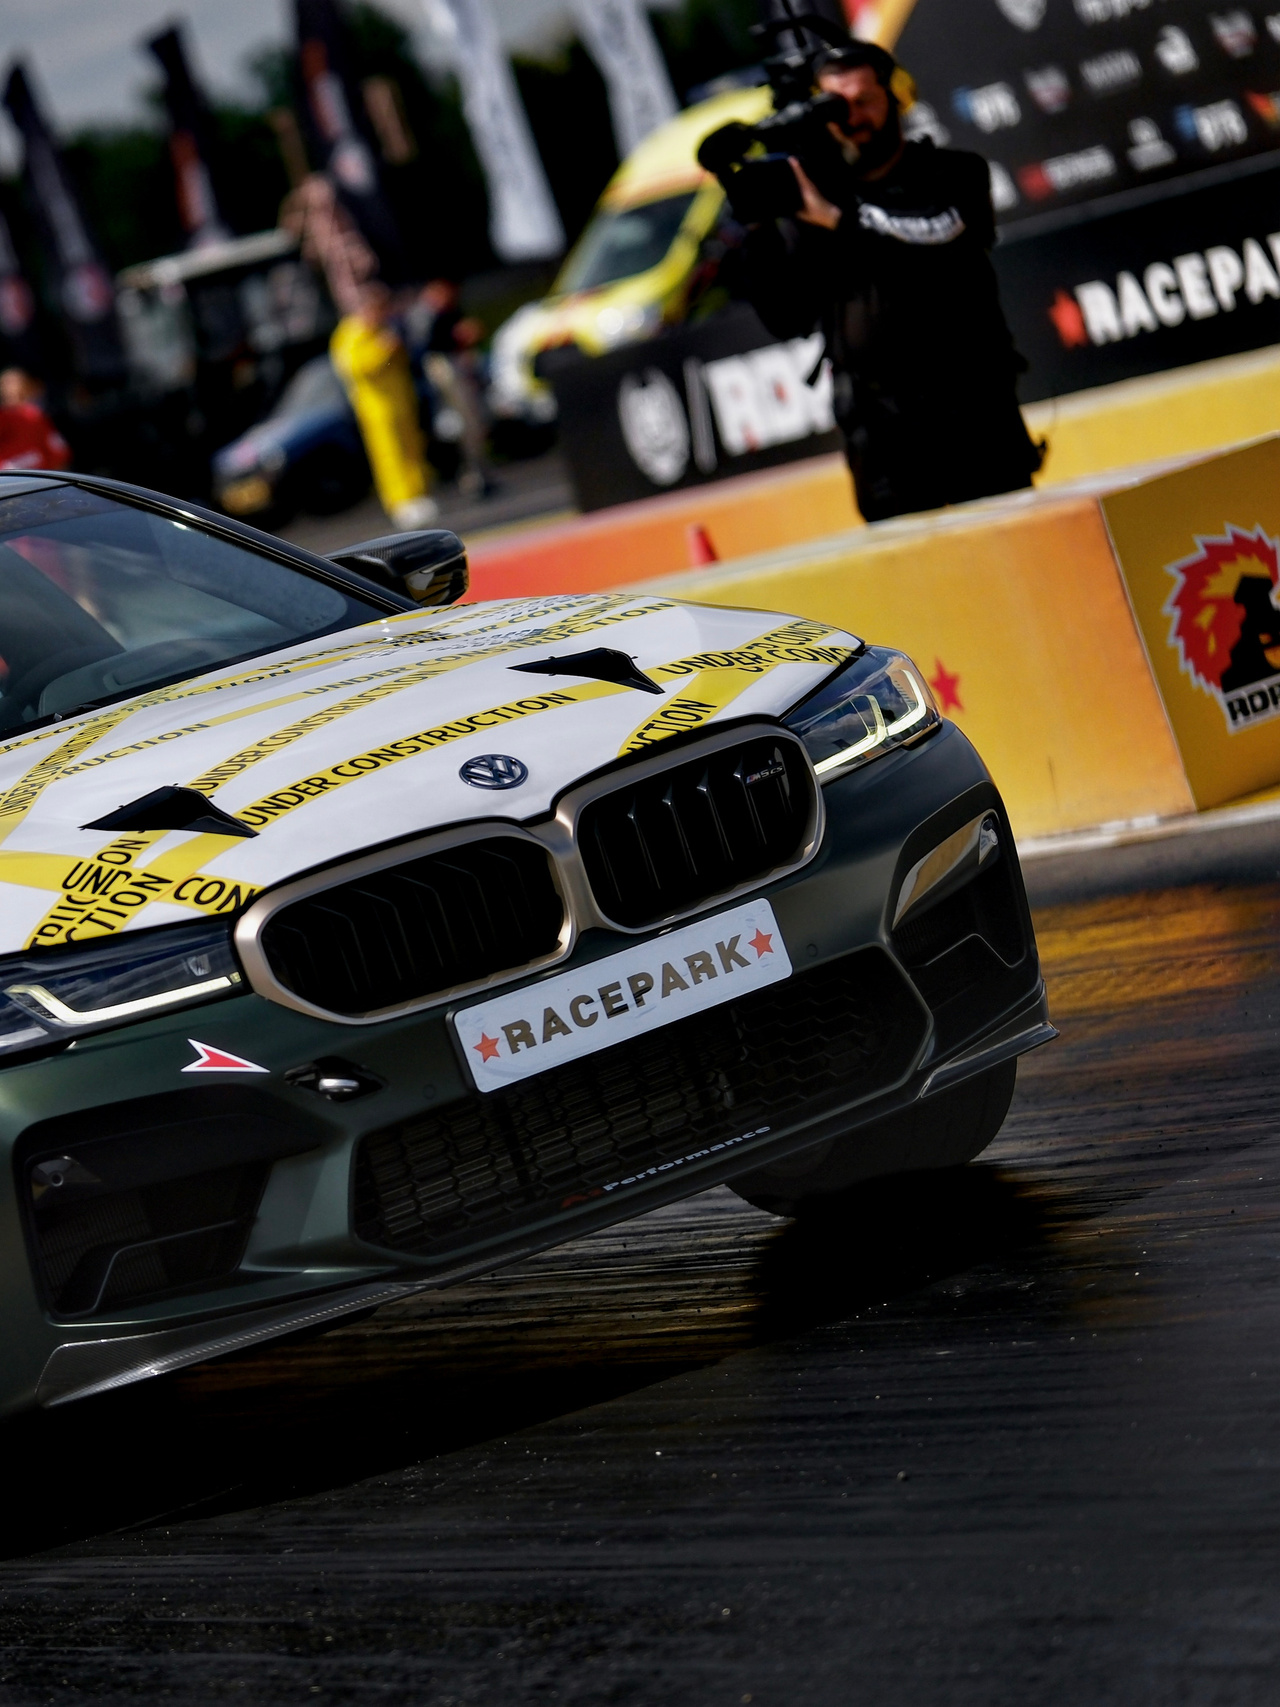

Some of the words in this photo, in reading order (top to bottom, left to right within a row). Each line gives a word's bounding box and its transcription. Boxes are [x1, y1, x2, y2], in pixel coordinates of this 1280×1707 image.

[657, 651, 775, 675] UNDER
[237, 775, 341, 827] UNDER
[332, 690, 579, 778] CONSTRUCTION
[501, 934, 751, 1055] RACEPARK
[603, 1126, 771, 1191] Performance
